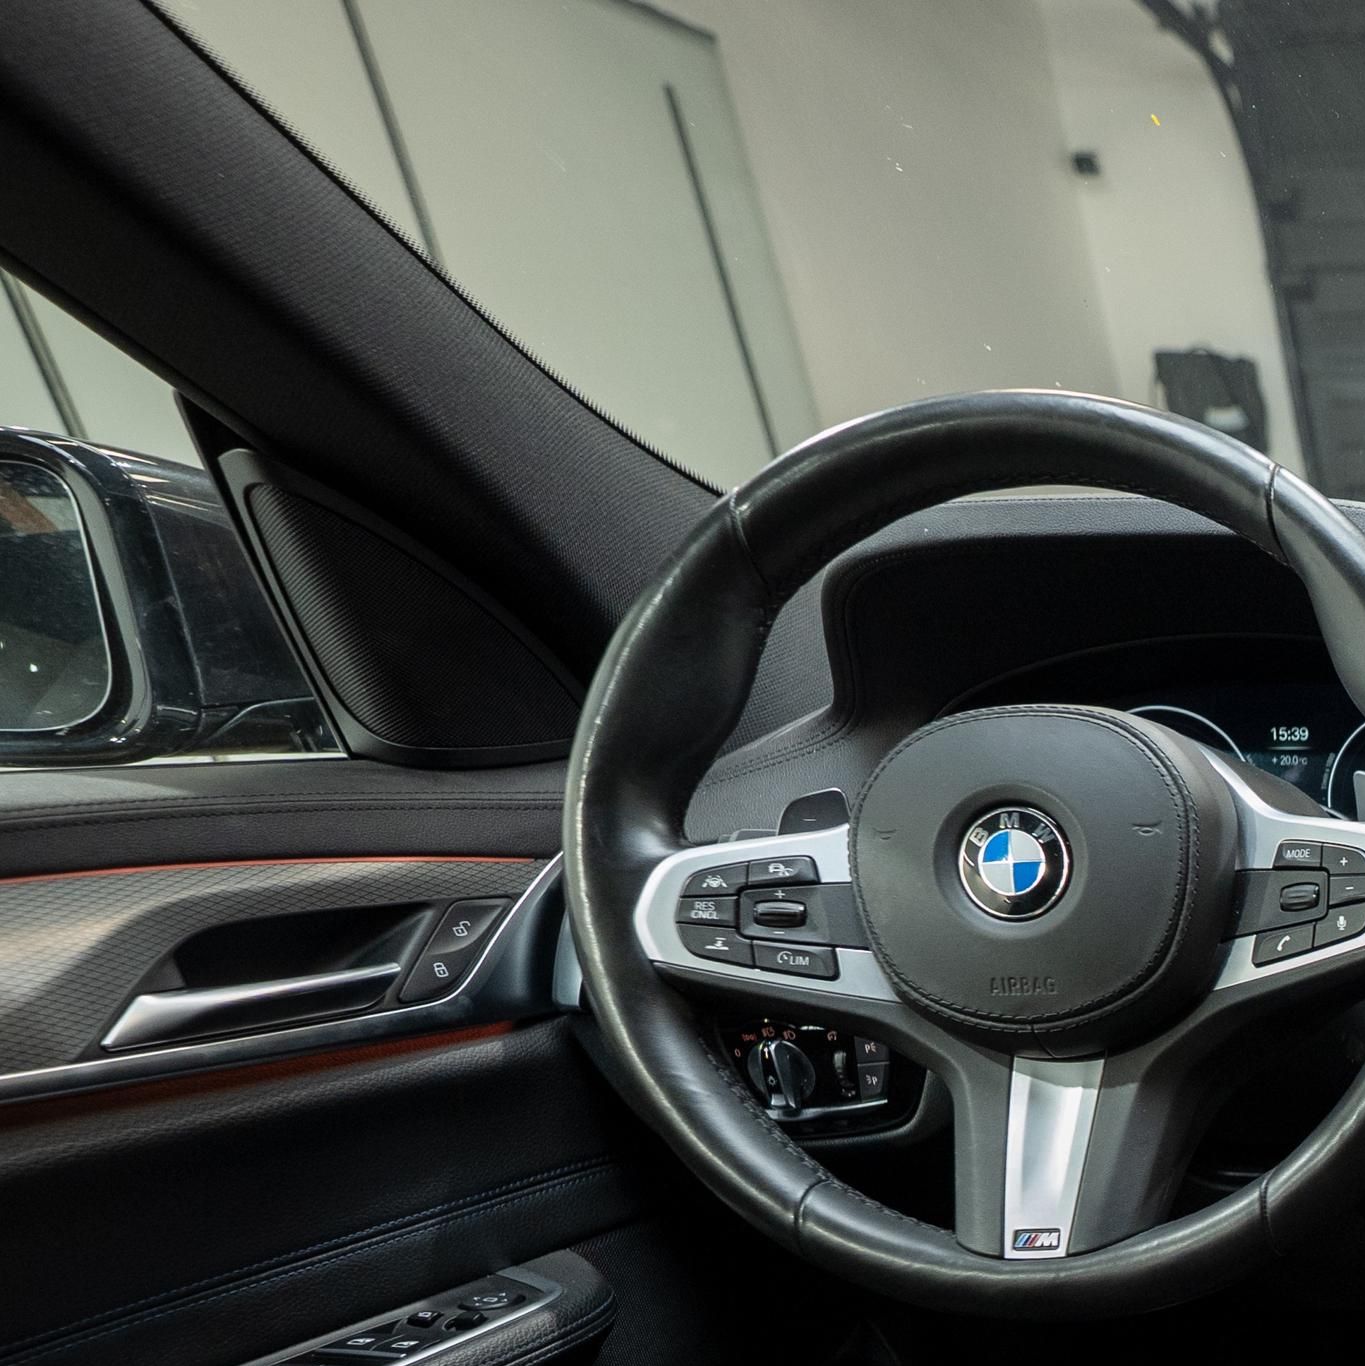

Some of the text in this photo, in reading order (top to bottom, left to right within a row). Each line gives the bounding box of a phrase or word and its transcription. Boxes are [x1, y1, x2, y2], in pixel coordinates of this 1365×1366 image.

[1270, 726, 1309, 741] 15:39
[969, 812, 1055, 847] BMW
[1285, 848, 1311, 859] MODE
[694, 901, 716, 911] RES
[690, 910, 719, 920] CNCL
[789, 955, 810, 966] LIM
[990, 976, 1058, 996] AIRBAG
